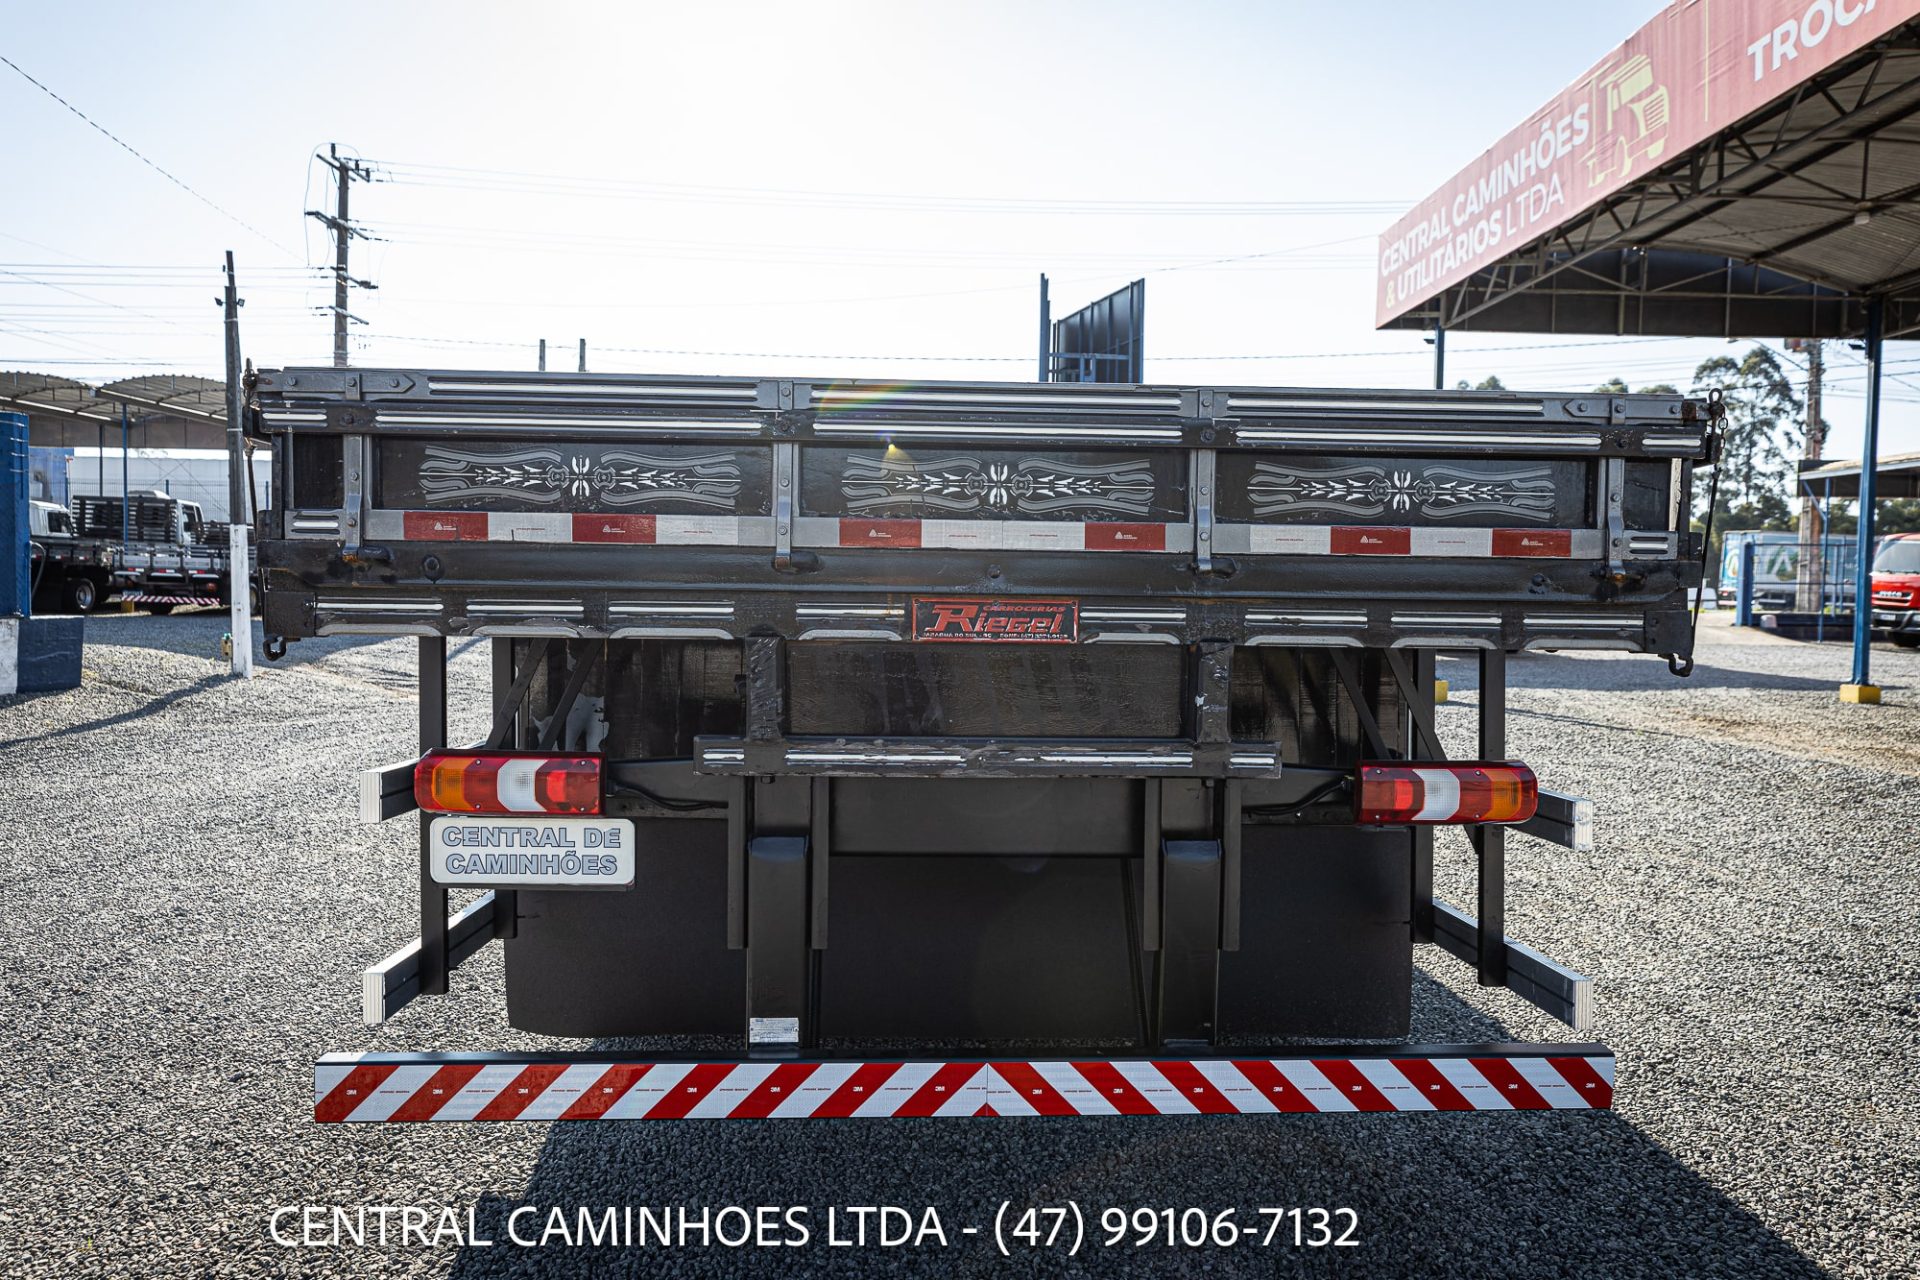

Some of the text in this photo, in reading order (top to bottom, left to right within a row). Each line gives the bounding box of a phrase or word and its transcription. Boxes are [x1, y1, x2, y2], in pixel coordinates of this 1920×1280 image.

[1381, 103, 1590, 277] CENTRAL CAMINHÕES
[1386, 172, 1564, 309] & UTILITÁRIOS LTDA
[442, 826, 621, 849] CENTRAL DE
[445, 850, 618, 876] CAMINHÕES
